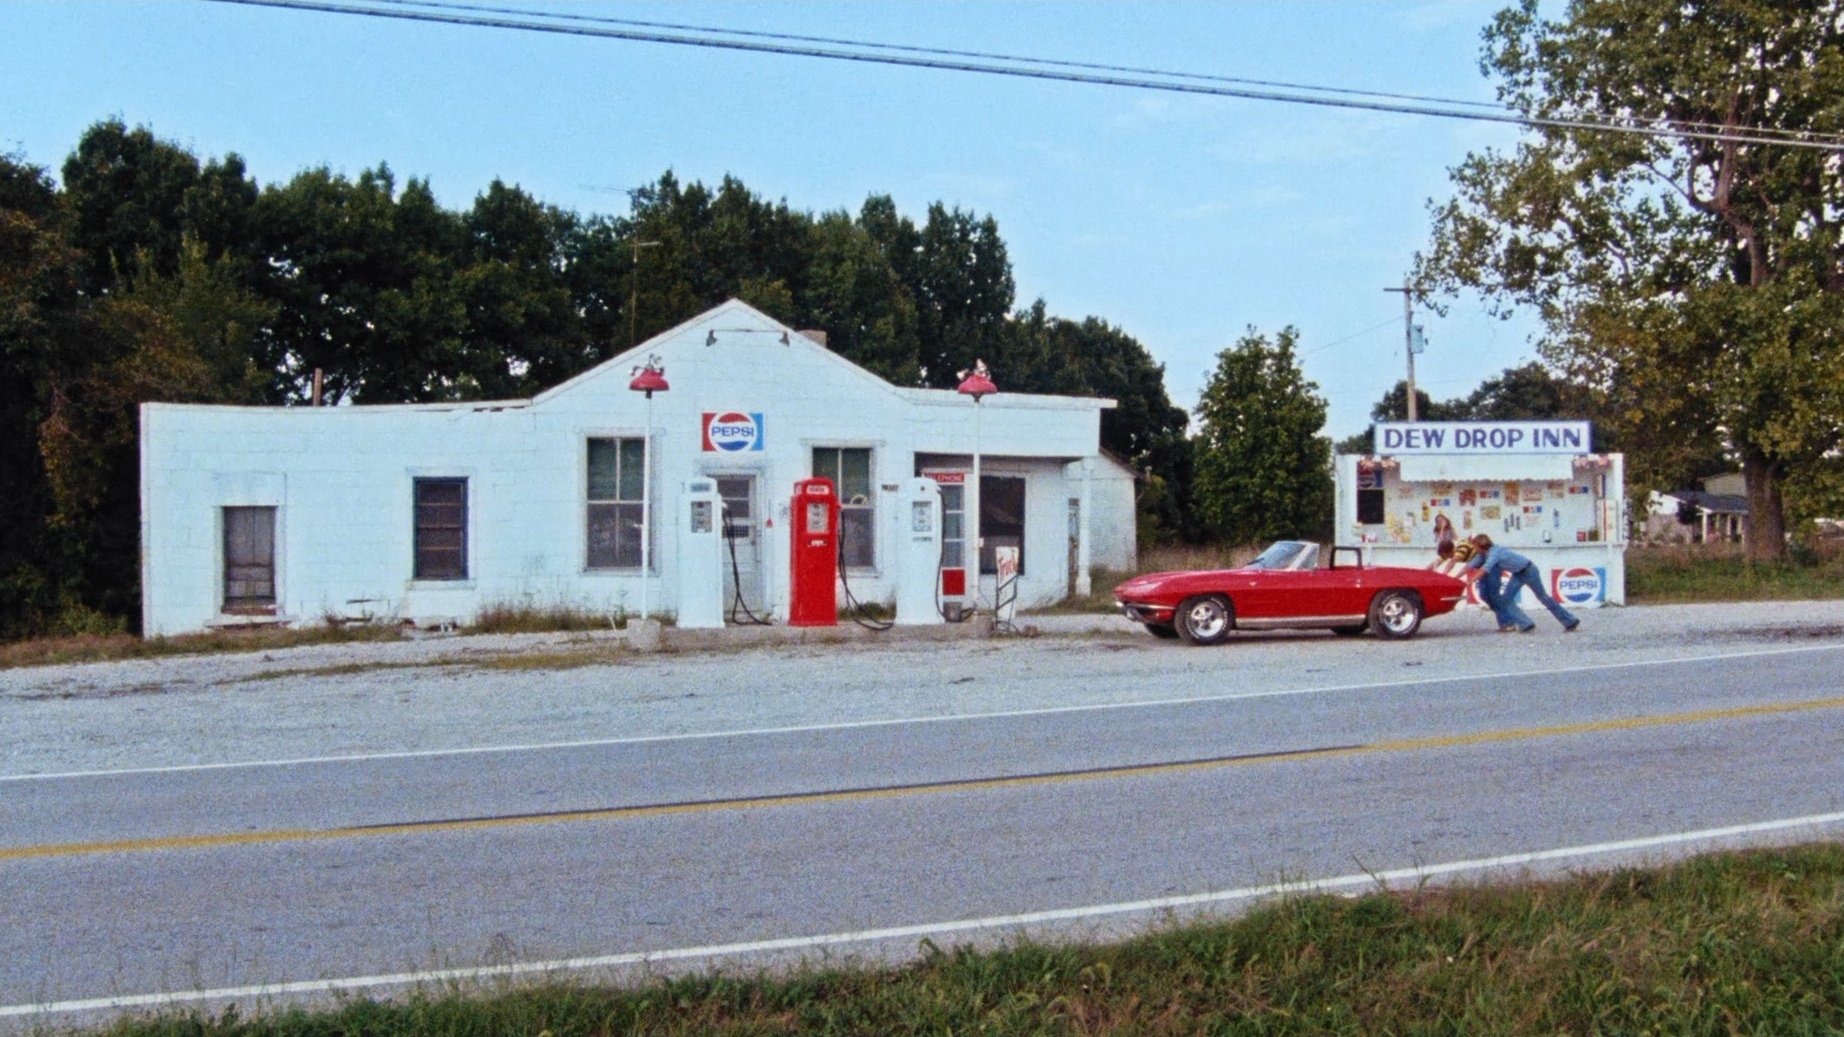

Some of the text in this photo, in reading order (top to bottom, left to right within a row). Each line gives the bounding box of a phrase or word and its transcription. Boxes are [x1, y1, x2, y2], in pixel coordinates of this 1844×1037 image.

[711, 426, 755, 437] PEPSI
[1384, 428, 1581, 449] DEW DROP INN
[1560, 580, 1598, 590] PEPSI
